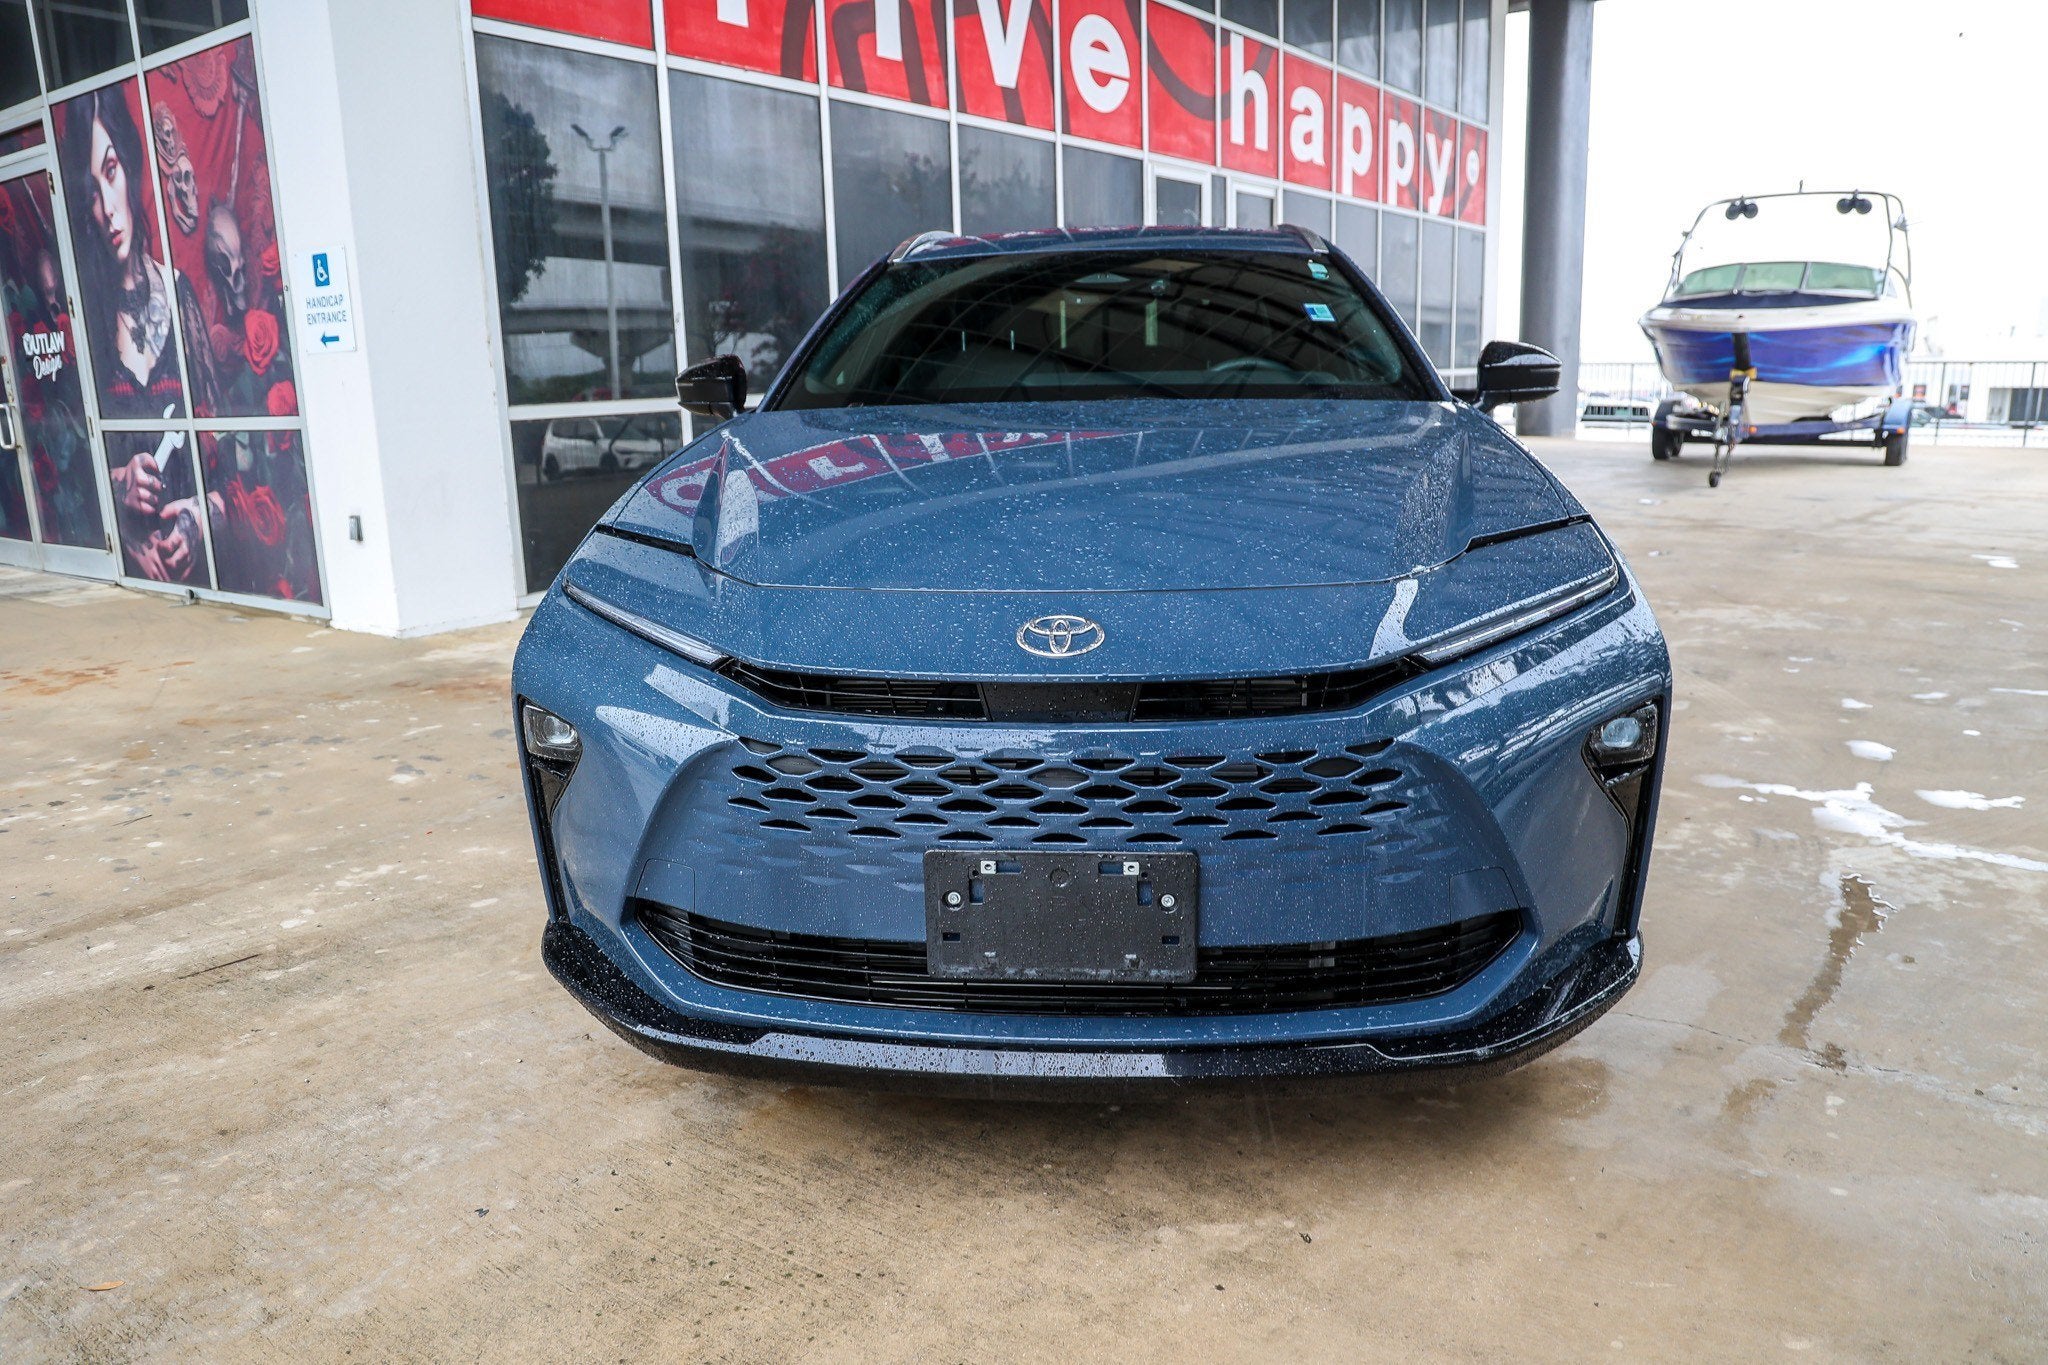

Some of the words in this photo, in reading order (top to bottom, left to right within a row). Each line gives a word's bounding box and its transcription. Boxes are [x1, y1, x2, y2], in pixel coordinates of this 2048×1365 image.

[305, 294, 344, 309] HANDICAP
[306, 310, 347, 325] ENTRANCE
[22, 331, 65, 355] OUTLAW
